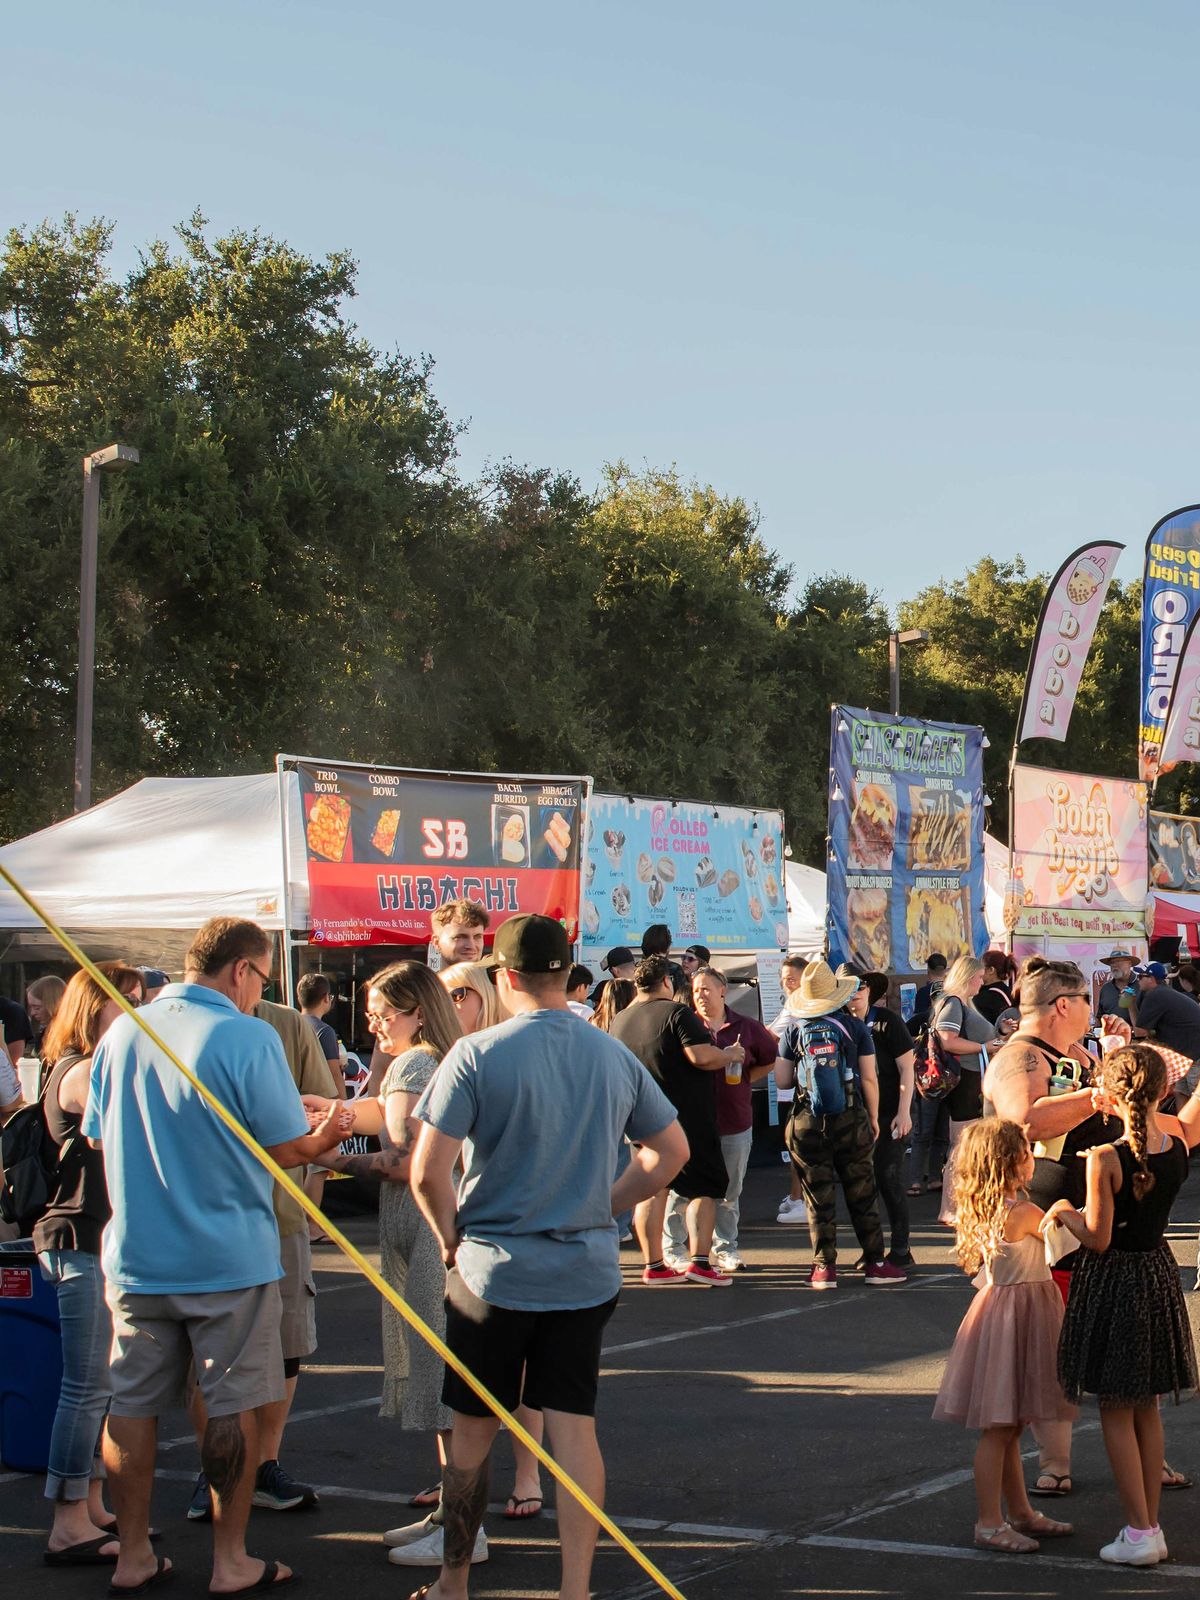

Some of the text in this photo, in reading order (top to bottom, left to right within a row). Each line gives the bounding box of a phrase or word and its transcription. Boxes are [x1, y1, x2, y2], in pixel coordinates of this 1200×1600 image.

[1039, 610, 1080, 725] boba
[854, 722, 963, 776] SMASH BURGERS
[316, 771, 338, 781] TRIO
[369, 774, 399, 785] COMBO
[314, 783, 340, 794] BOWL
[373, 786, 398, 797] BOWL
[497, 783, 522, 793] BACHI
[542, 785, 572, 796] HIBACHI
[494, 793, 528, 805] BURRITO
[537, 796, 578, 807] EGG ROLLS
[1046, 781, 1112, 837] boba
[651, 804, 708, 837] ROLLED
[421, 816, 469, 860] SB
[651, 839, 710, 854] ICE CREAM
[1045, 828, 1119, 876] bestie
[376, 873, 519, 912] HIBACHI
[313, 918, 427, 929] By Fernando's Churros & Deli inc.
[325, 930, 371, 941] @sbhibachi
[339, 1136, 368, 1155] ACHI
